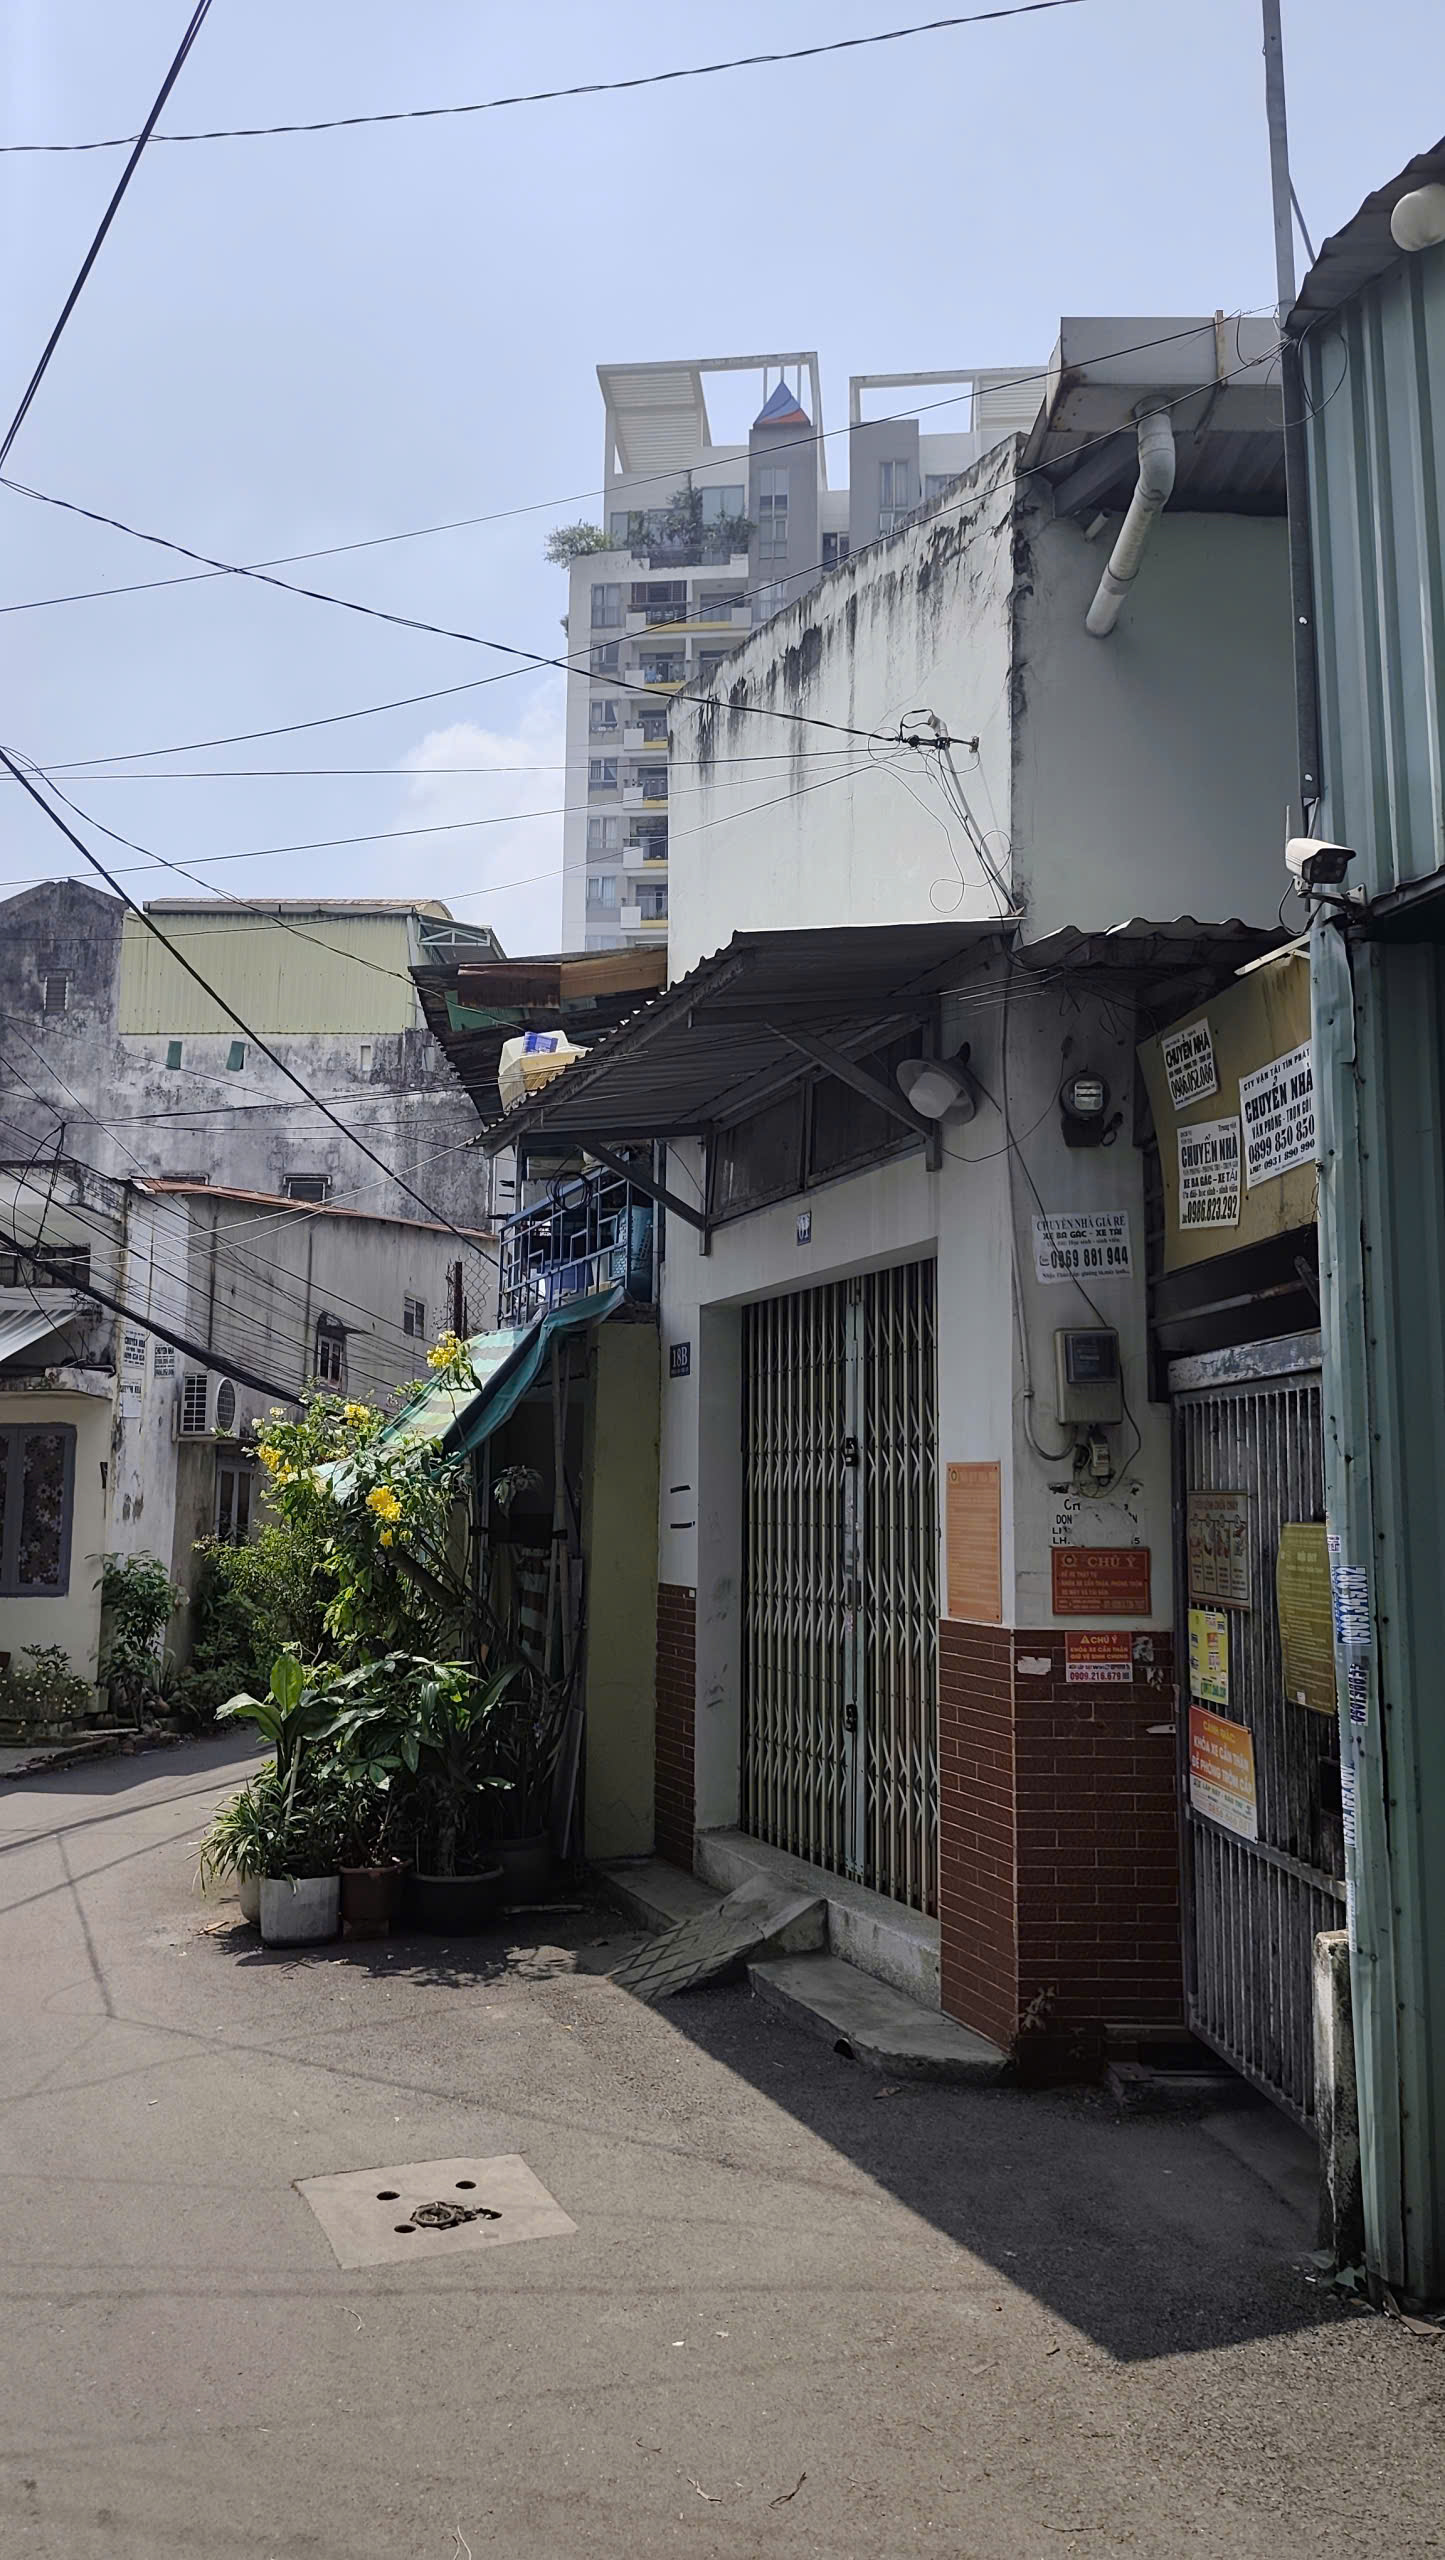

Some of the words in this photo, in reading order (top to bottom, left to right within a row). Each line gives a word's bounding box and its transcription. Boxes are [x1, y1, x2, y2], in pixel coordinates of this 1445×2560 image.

[1245, 1076, 1287, 1123] CHUYỂN
[1181, 1134, 1218, 1168] CHUYỂN
[1219, 1132, 1238, 1161] NHÀ
[1248, 1136, 1272, 1165] 0899
[1275, 1125, 1293, 1152] 850
[1296, 1114, 1315, 1142] 850
[1264, 1154, 1281, 1169] 0931
[1284, 1146, 1299, 1161] 890
[1300, 1138, 1315, 1153] 990
[1096, 1228, 1107, 1237] XE
[1083, 1247, 1103, 1267] 881
[1106, 1246, 1128, 1266] 944
[672, 1346, 688, 1368] 18B
